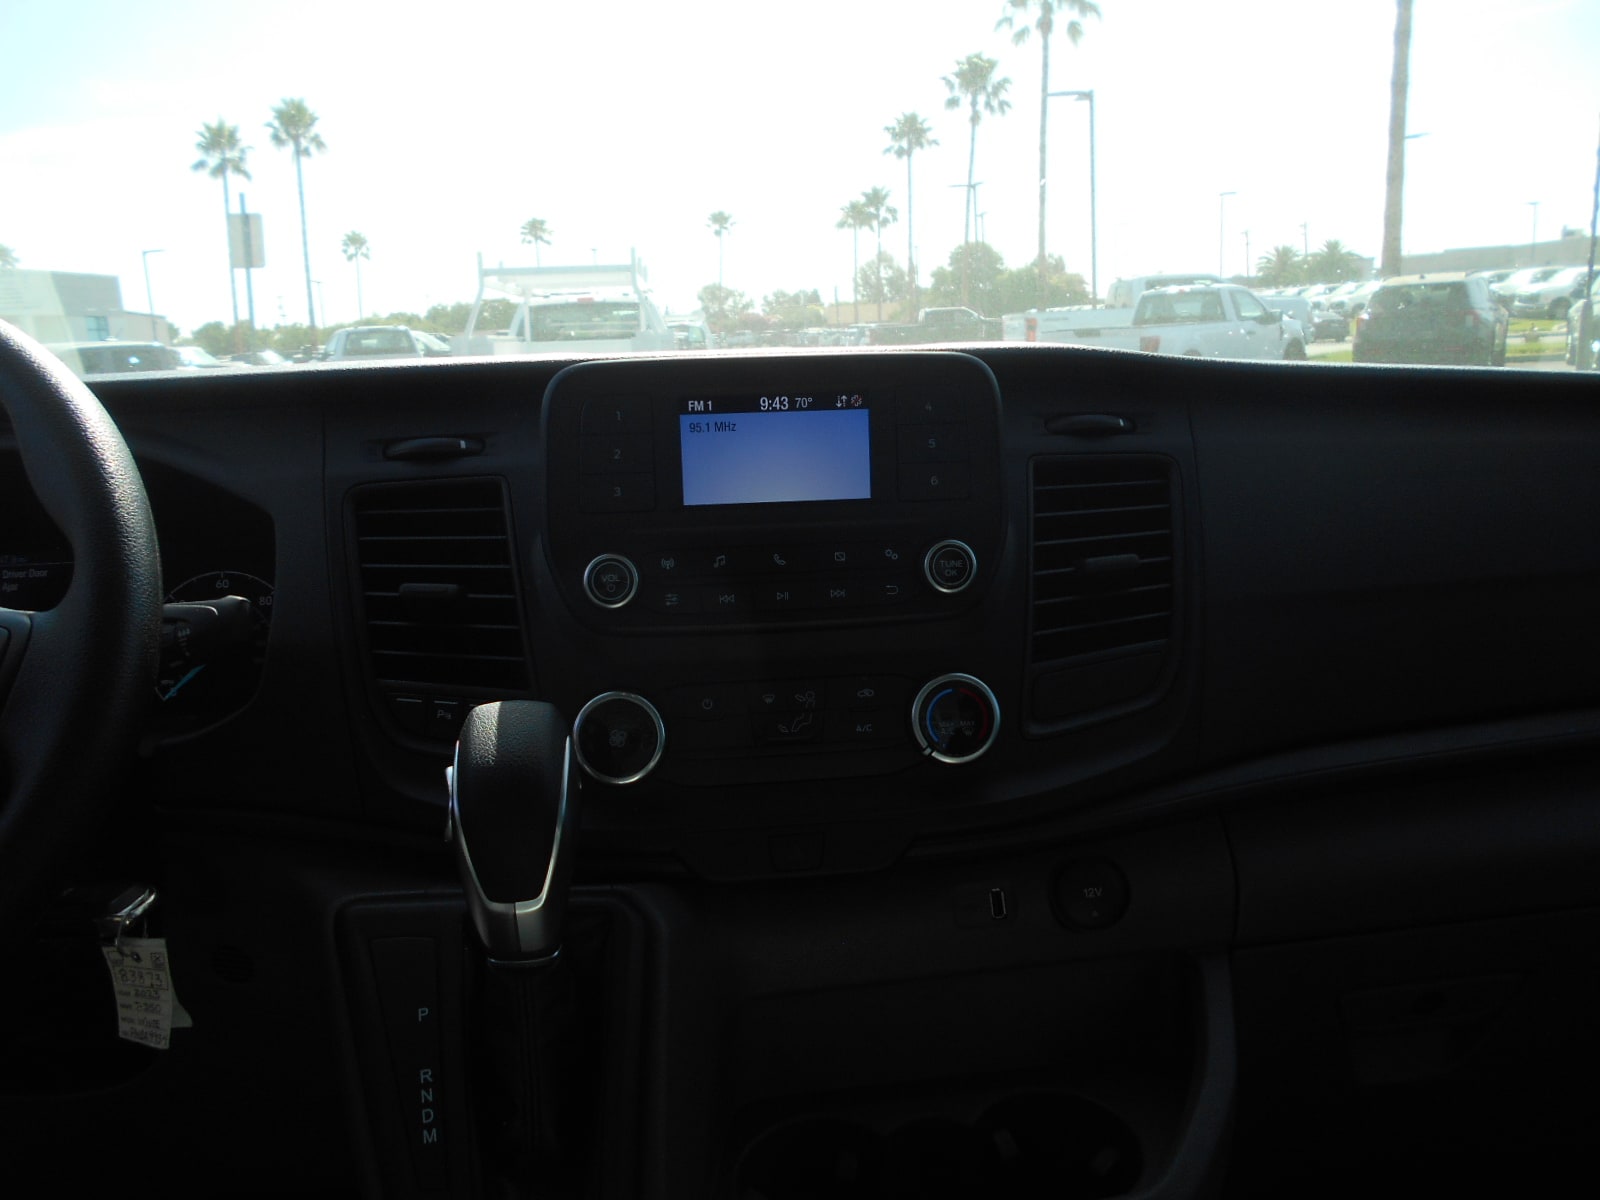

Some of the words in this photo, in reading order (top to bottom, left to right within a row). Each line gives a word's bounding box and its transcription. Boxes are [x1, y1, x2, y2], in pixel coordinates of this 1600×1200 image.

[688, 400, 704, 411] FM
[707, 400, 712, 411] 1
[759, 396, 789, 411] 9:43
[794, 397, 813, 409] 70°
[689, 422, 710, 433] 95.1
[714, 421, 737, 432] MHz
[927, 438, 936, 449] 5
[614, 448, 621, 459] 2
[930, 475, 938, 486] 6
[614, 486, 621, 497] 3
[939, 559, 963, 567] TUNE
[215, 578, 229, 589] 60
[601, 574, 621, 582] VOL
[259, 596, 273, 606] 80
[856, 723, 873, 732] A/C
[1083, 887, 1104, 898] 12V
[417, 1007, 429, 1023] P
[419, 1068, 433, 1084] R
[420, 1087, 433, 1104] N
[421, 1107, 434, 1124] D
[423, 1127, 438, 1145] M
